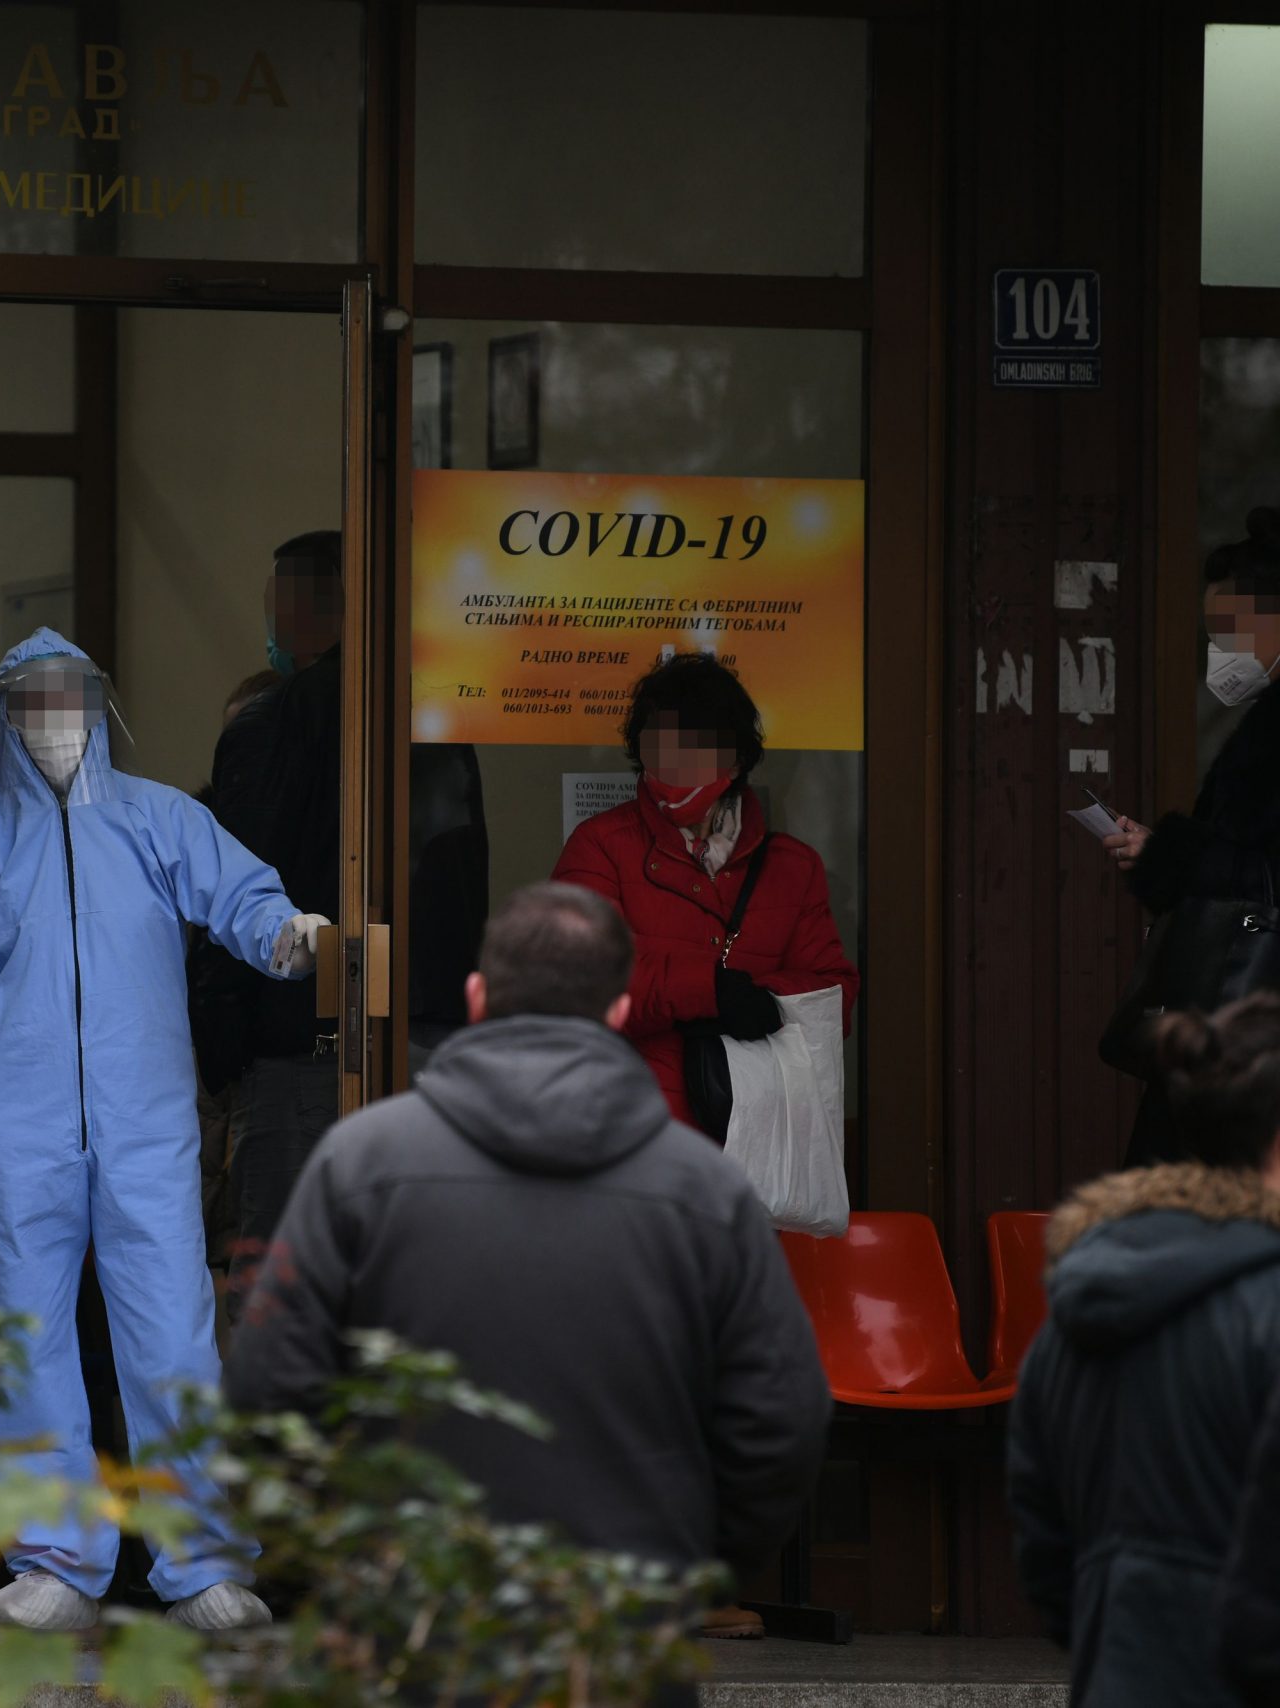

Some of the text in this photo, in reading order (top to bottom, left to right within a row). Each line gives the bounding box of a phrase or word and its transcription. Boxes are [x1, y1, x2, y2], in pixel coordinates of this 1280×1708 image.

[1008, 278, 1090, 340] 104
[1000, 363, 1066, 381] OMLADINSKIH
[499, 510, 767, 560] COVID-19
[460, 595, 802, 614] АМБУЛАНТА ЗА ПАЦИЈЕНТЕ СА ФЕБРИЛНИМ
[464, 612, 786, 631] СТАЊИМА И РЕСПИРАТОРНИМ ТЕГОБАМА
[520, 650, 629, 666] РАДНО ВРЕМЕ
[501, 688, 571, 700] 011/2095-414
[579, 689, 632, 701] 060/1013-
[503, 703, 572, 715] 060/1013-693
